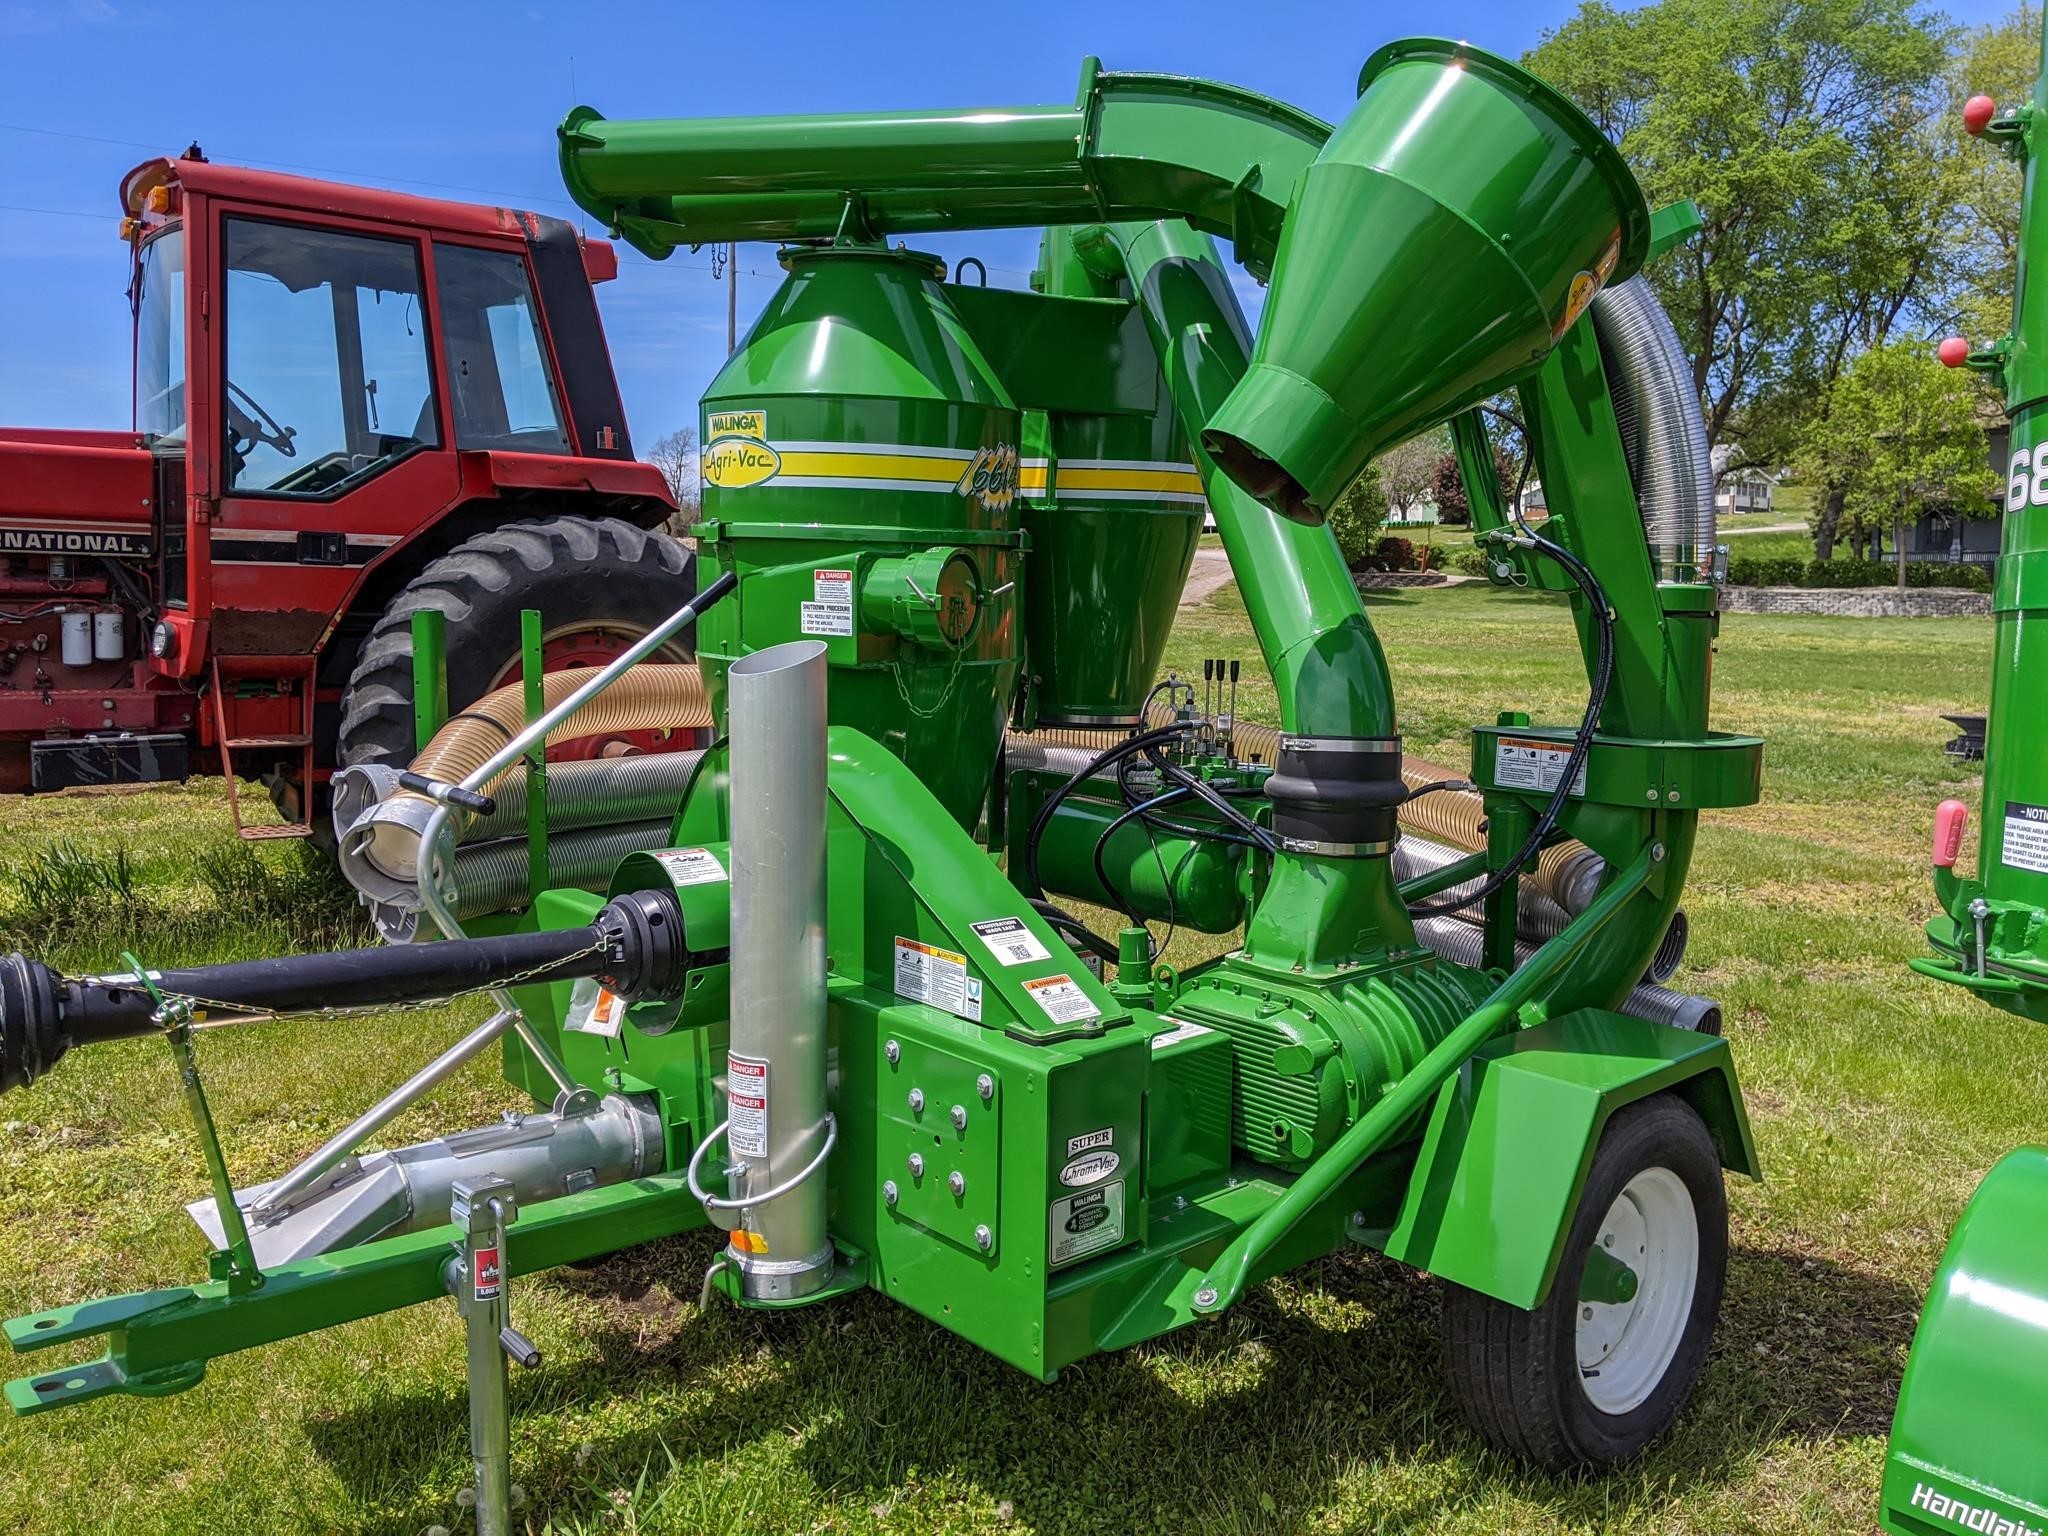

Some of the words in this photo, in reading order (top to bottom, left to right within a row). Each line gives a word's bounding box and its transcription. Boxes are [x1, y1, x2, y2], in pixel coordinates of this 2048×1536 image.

[712, 415, 758, 432] WALINGA
[706, 449, 773, 481] Agri-Vac
[0, 532, 133, 552] NATIONAL
[733, 1062, 760, 1076] DANGER
[733, 1094, 760, 1108] DANGER
[1071, 1131, 1109, 1150] SUPER
[1074, 1192, 1102, 1208] WALINGA
